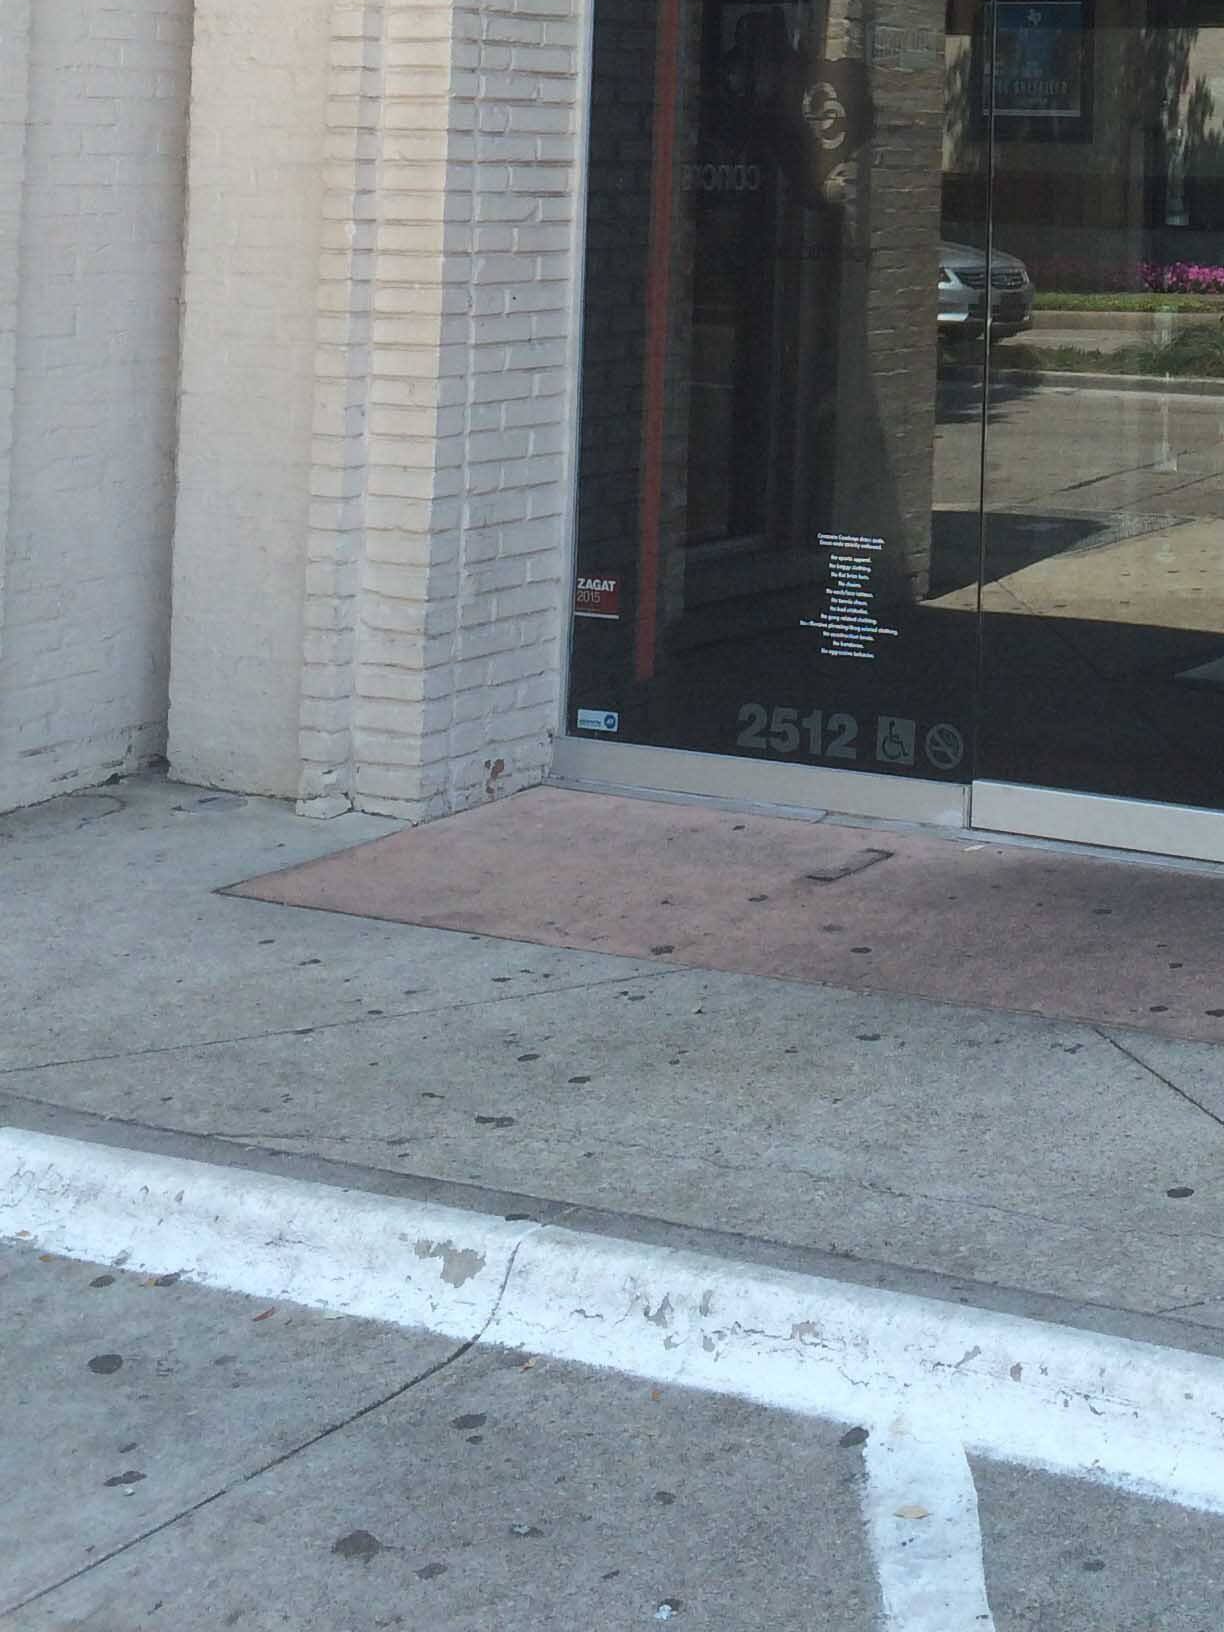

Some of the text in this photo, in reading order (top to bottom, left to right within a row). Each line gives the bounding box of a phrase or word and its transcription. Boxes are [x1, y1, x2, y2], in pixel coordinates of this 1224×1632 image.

[577, 578, 617, 592] ZAGAT
[577, 590, 601, 603] 2015
[736, 703, 858, 759] 2512
